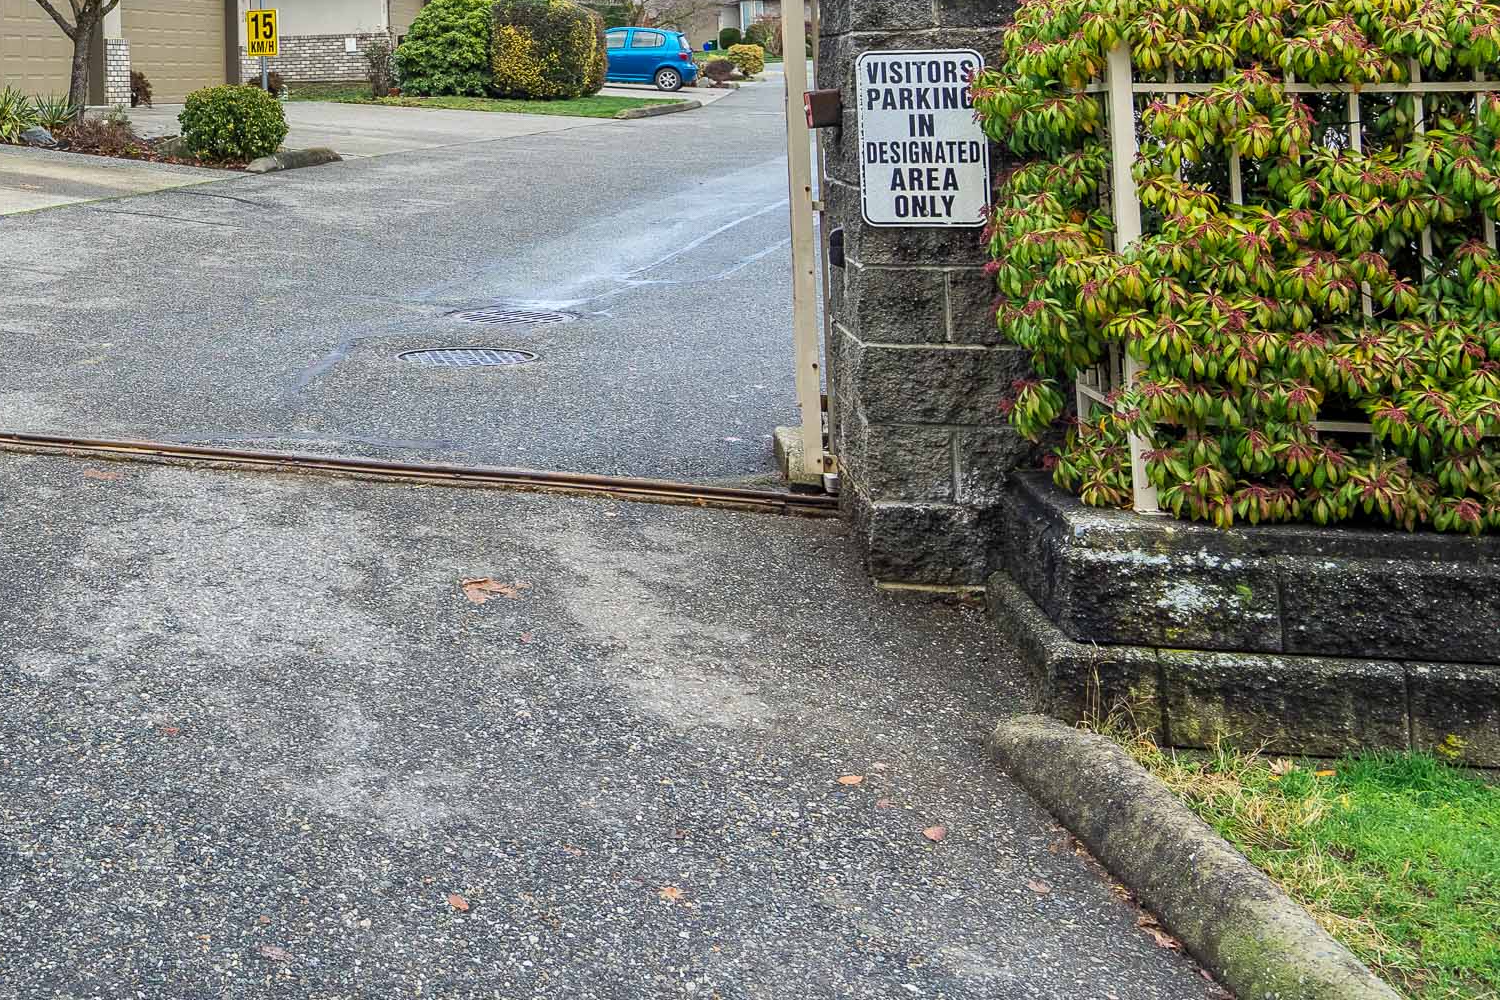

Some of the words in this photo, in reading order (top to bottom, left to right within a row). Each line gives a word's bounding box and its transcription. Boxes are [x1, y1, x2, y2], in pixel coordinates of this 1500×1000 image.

[251, 13, 274, 39] 15
[251, 41, 275, 53] KM/H
[866, 60, 974, 85] VISITORS
[867, 87, 974, 111] PARKING
[909, 114, 935, 137] IN
[866, 141, 980, 165] DESIGNATED
[890, 168, 959, 191] AREA
[895, 195, 955, 218] ONLY
